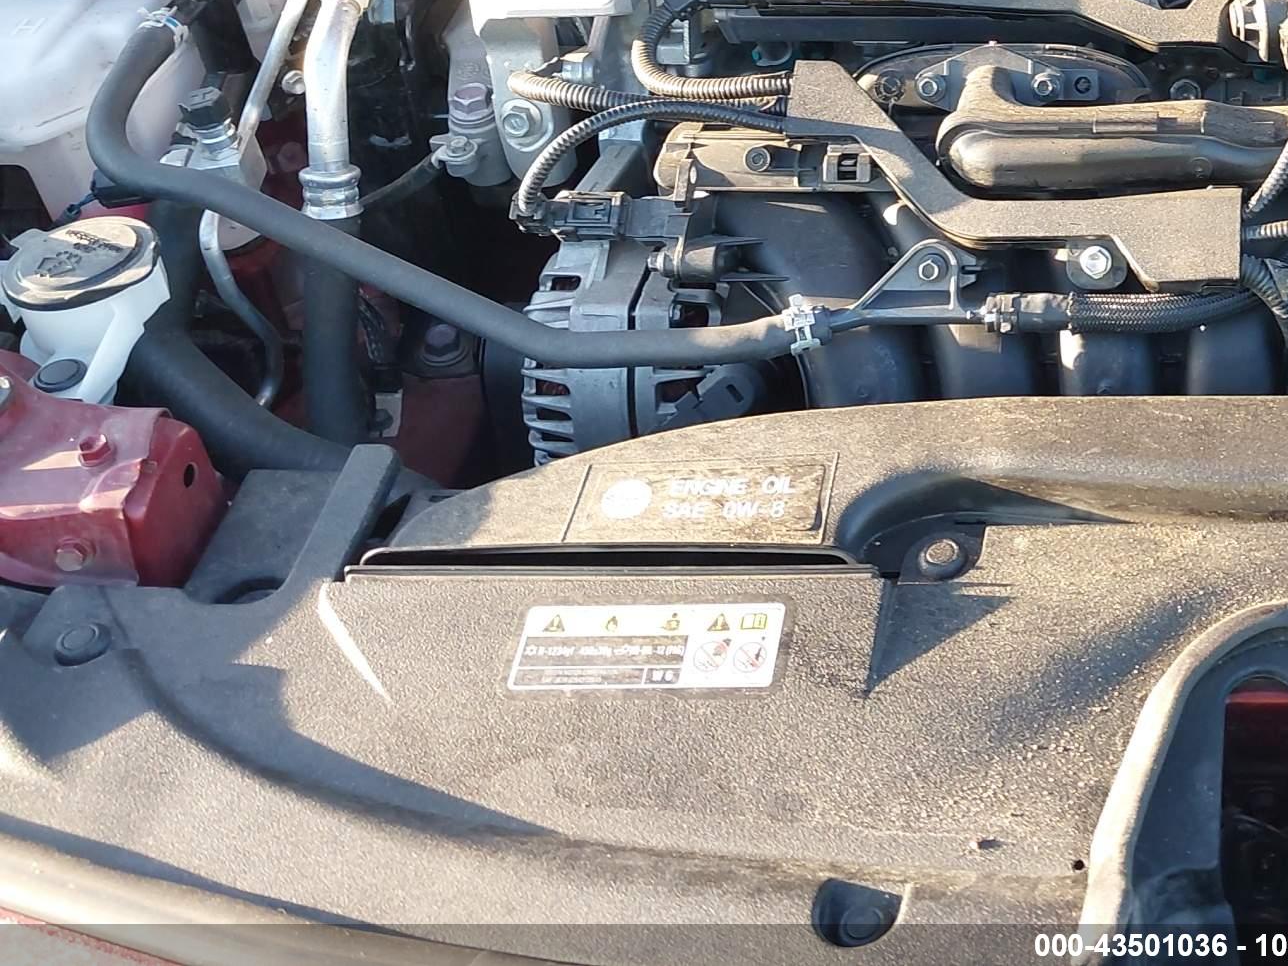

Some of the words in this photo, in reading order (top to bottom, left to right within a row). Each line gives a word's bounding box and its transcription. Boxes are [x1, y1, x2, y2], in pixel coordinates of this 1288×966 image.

[670, 477, 748, 495] ENGINE
[762, 475, 796, 494] OIL
[663, 501, 705, 518] SAE
